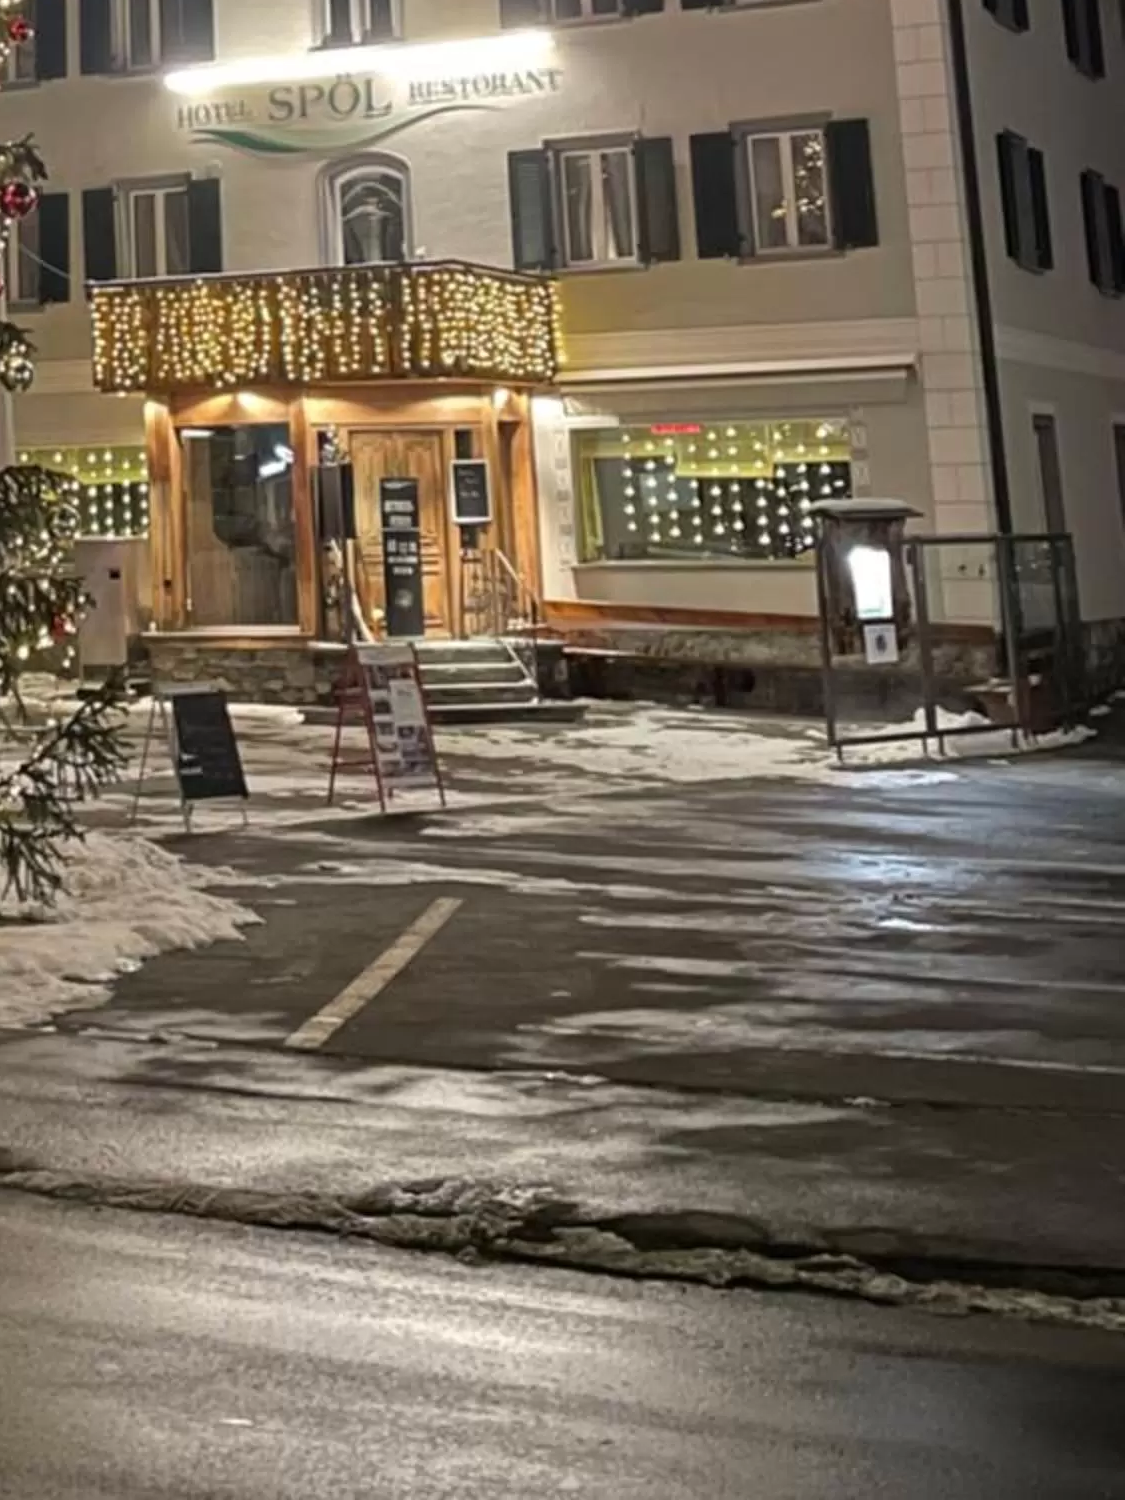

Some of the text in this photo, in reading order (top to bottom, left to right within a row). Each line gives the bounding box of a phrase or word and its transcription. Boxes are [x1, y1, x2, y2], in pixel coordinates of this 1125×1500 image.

[178, 67, 563, 128] HOTEL SPÖL RESTORANT
